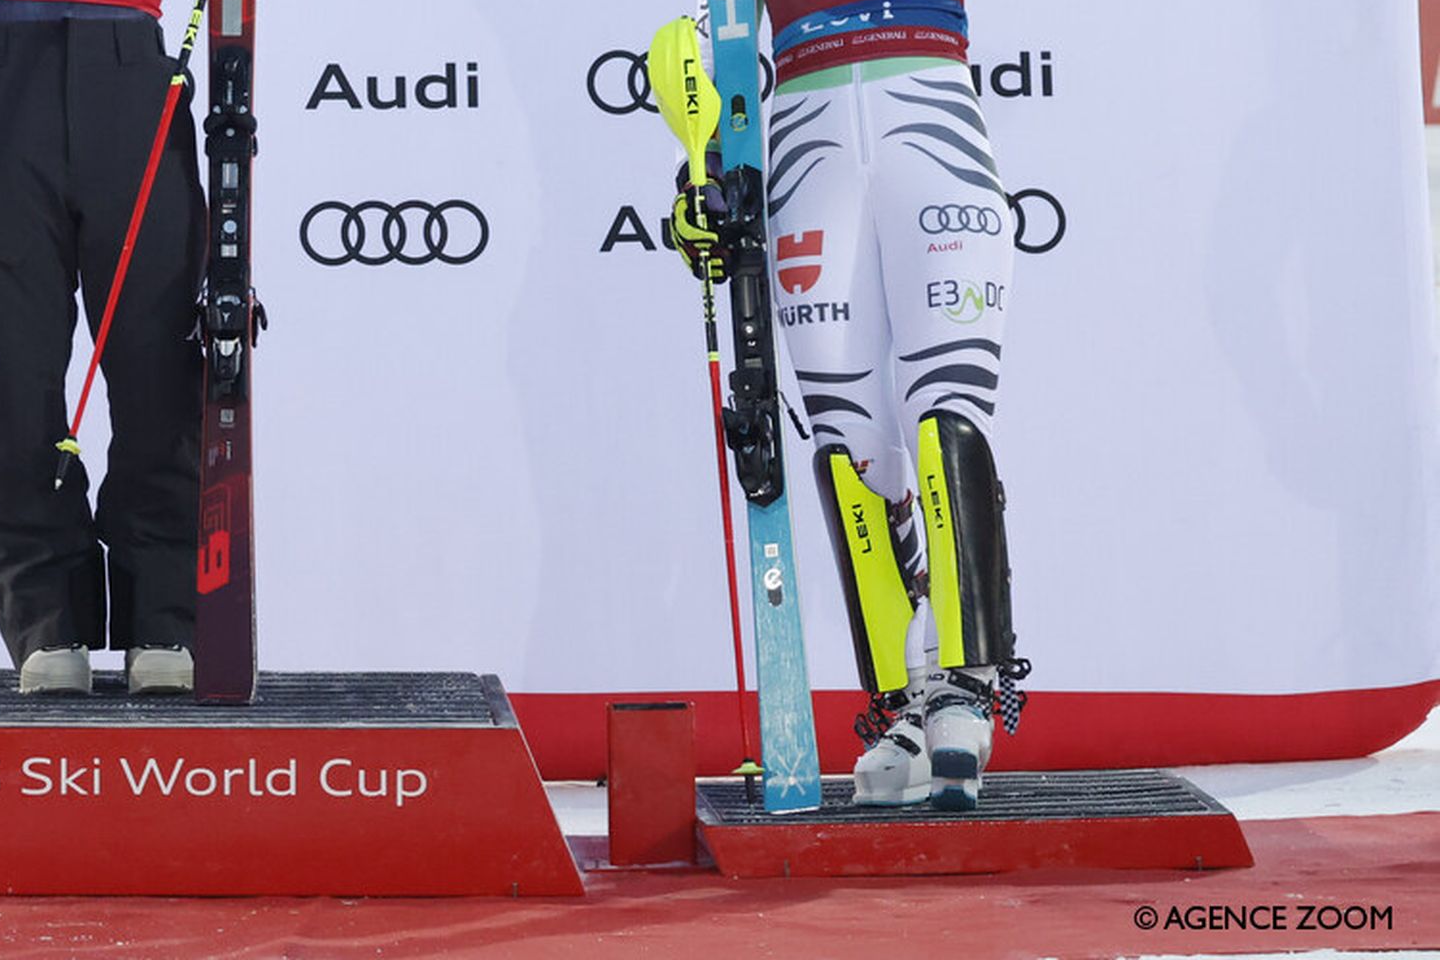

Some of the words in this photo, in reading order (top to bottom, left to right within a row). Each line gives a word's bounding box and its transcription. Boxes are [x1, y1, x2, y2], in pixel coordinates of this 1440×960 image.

[305, 62, 479, 110] Audi
[683, 58, 698, 115] LEKI
[926, 241, 964, 254] Audi
[927, 474, 944, 529] LEKI
[852, 503, 872, 554] LEKI
[21, 757, 101, 796] Ski
[119, 757, 297, 797] World
[319, 758, 428, 807] Cup
